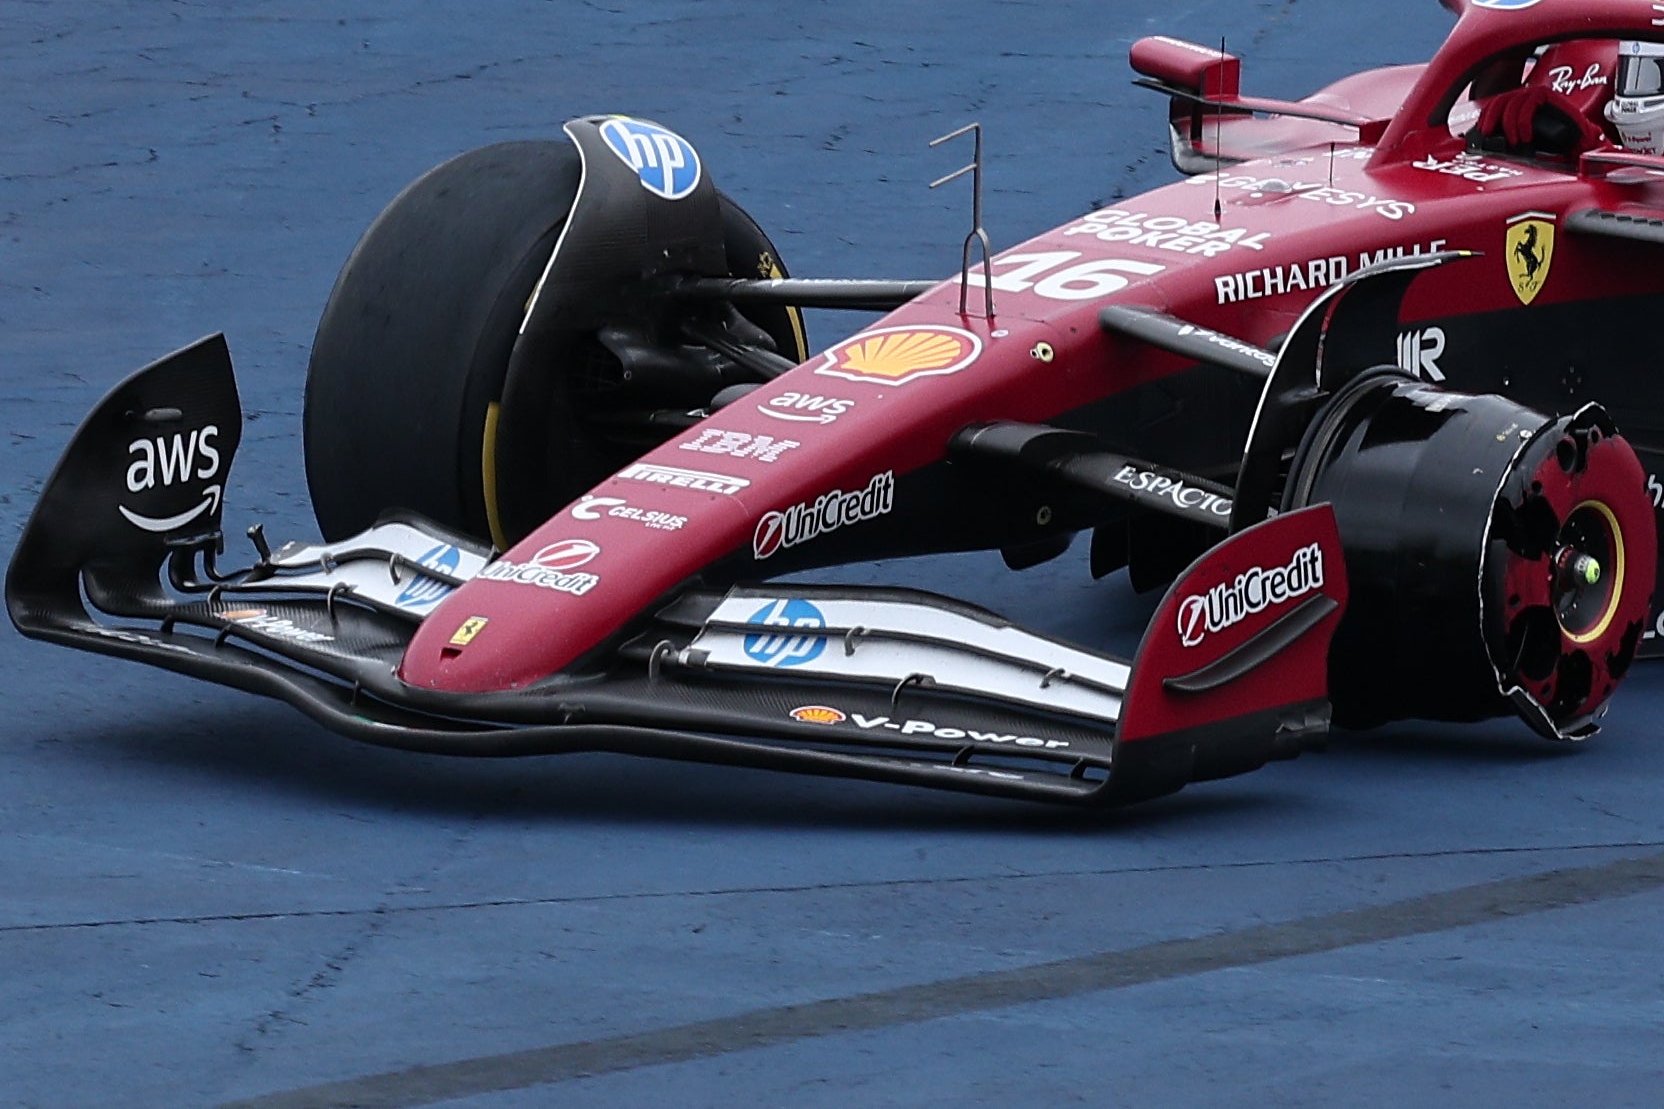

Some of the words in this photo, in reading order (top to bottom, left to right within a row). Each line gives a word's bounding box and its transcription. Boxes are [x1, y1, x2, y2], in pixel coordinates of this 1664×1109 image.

[612, 120, 691, 200] hp
[1064, 220, 1232, 258] POKER
[1083, 209, 1275, 250] GLOBAL
[955, 251, 1166, 300] 16
[1215, 256, 1348, 304] RICHARD
[769, 392, 855, 414] aws
[125, 424, 220, 493] aws
[677, 428, 801, 462] IBM
[617, 463, 751, 495] PIRELLI
[608, 506, 688, 528] CELSIUS
[782, 470, 895, 546] UniCredit
[396, 543, 460, 608] hp
[479, 561, 600, 595] UniCredit
[1206, 542, 1324, 633] UniCredit
[750, 598, 824, 667] hp
[851, 713, 1070, 750] V-Power
